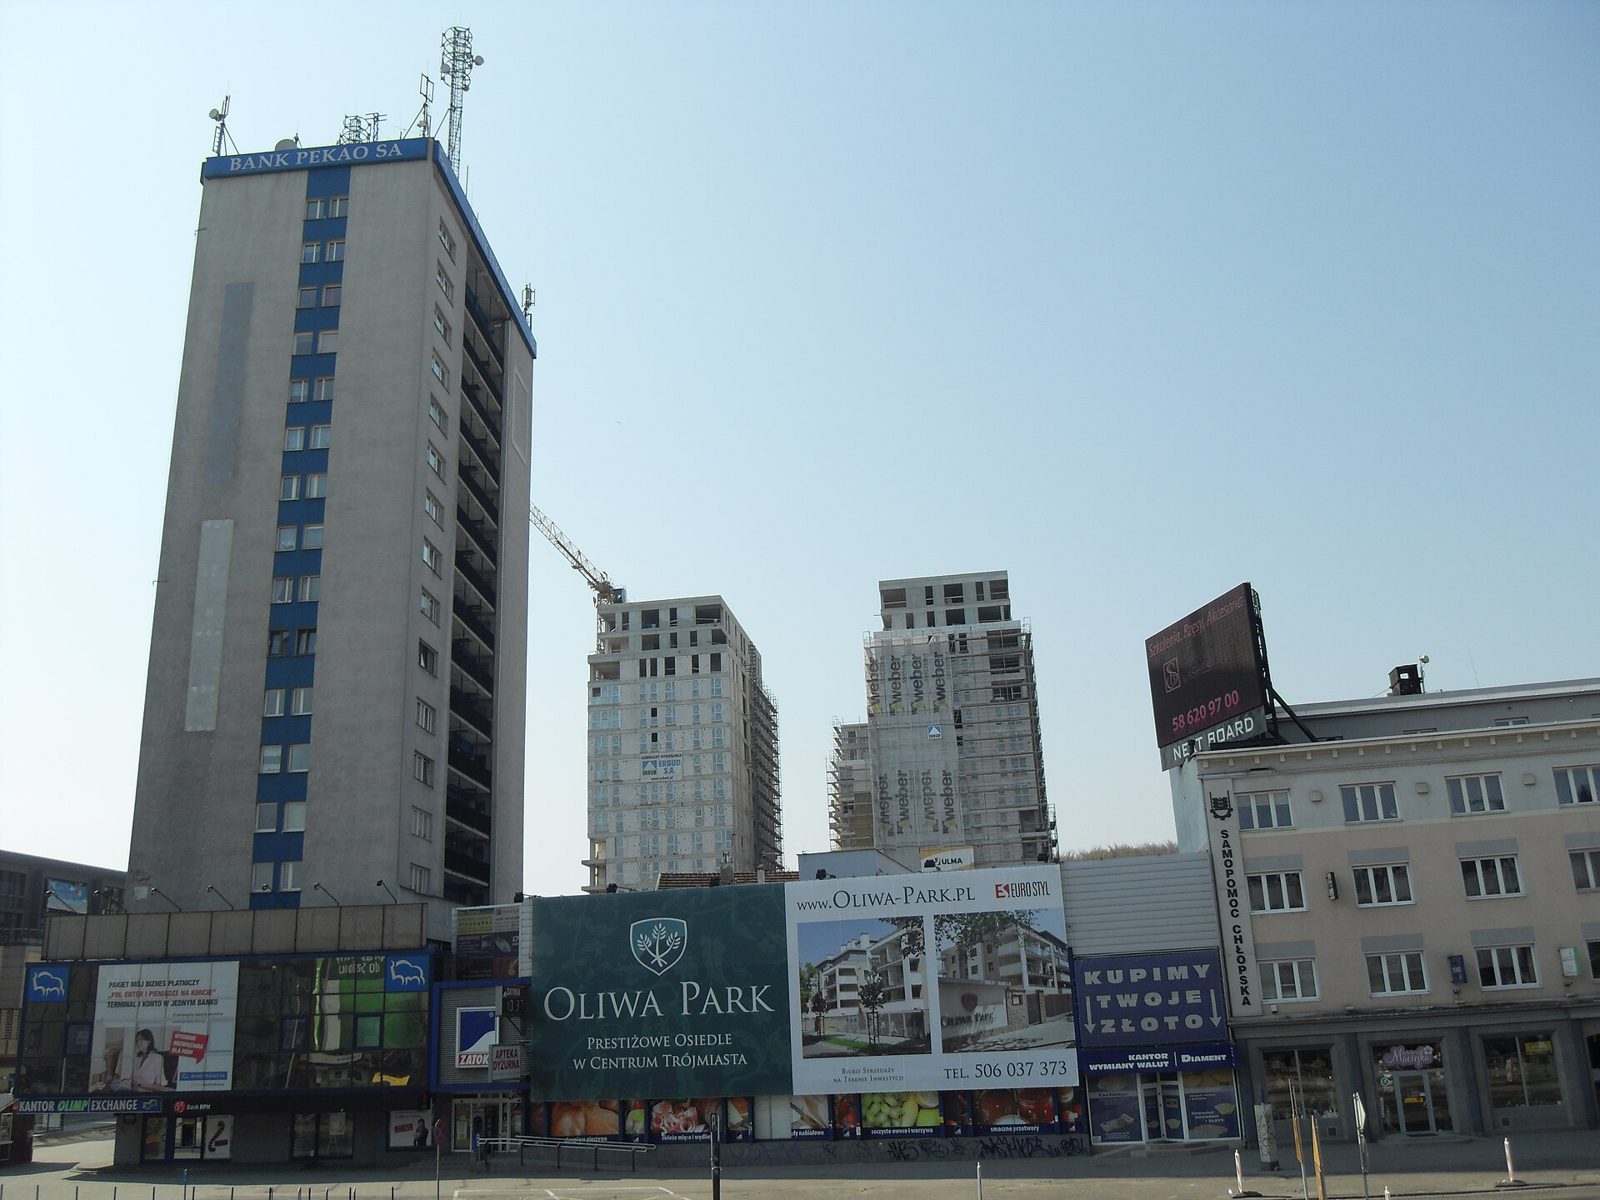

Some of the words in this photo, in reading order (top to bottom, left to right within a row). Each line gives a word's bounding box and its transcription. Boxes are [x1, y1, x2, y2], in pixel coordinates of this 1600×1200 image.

[230, 153, 289, 171] BANK
[296, 146, 369, 165] PEKAO
[375, 143, 403, 158] SA
[888, 655, 902, 704] weber
[910, 653, 924, 703] weber
[932, 652, 946, 702] weber
[1172, 714, 1185, 732] 58
[1187, 704, 1206, 725] 620
[1208, 697, 1221, 716] 97
[1224, 690, 1239, 708] 00
[1173, 737, 1202, 761] NET
[895, 770, 910, 822] weber
[940, 769, 955, 822] weber
[1220, 829, 1240, 918] SAMOPOMOC
[1232, 925, 1251, 1006] CHŁOPSKA
[1084, 964, 1210, 985] KUPIMY
[543, 986, 664, 1021] OLIWA
[680, 981, 775, 1015] PARK
[1096, 990, 1202, 1009] TWOJE
[1100, 1014, 1203, 1033] ZŁOTO
[587, 1034, 670, 1050] PRESTIŻOWE
[674, 1033, 732, 1047] OSIEDLE
[459, 1054, 489, 1065] ZATOK
[495, 1049, 518, 1059] APTEKA
[590, 1056, 658, 1069] CENTRUM
[662, 1053, 748, 1069] TRÓJMIASTA
[1128, 1053, 1169, 1061] KANTOR
[1181, 1054, 1227, 1063] DIAMENT
[974, 1063, 1001, 1078] 506
[1006, 1062, 1034, 1077] 037
[1040, 1060, 1067, 1076] 373
[1089, 1063, 1135, 1071] WYMIANY
[19, 1101, 55, 1112] KANTOR
[57, 1100, 88, 1111] OLIMP
[91, 1099, 138, 1111] EXCHANGE
